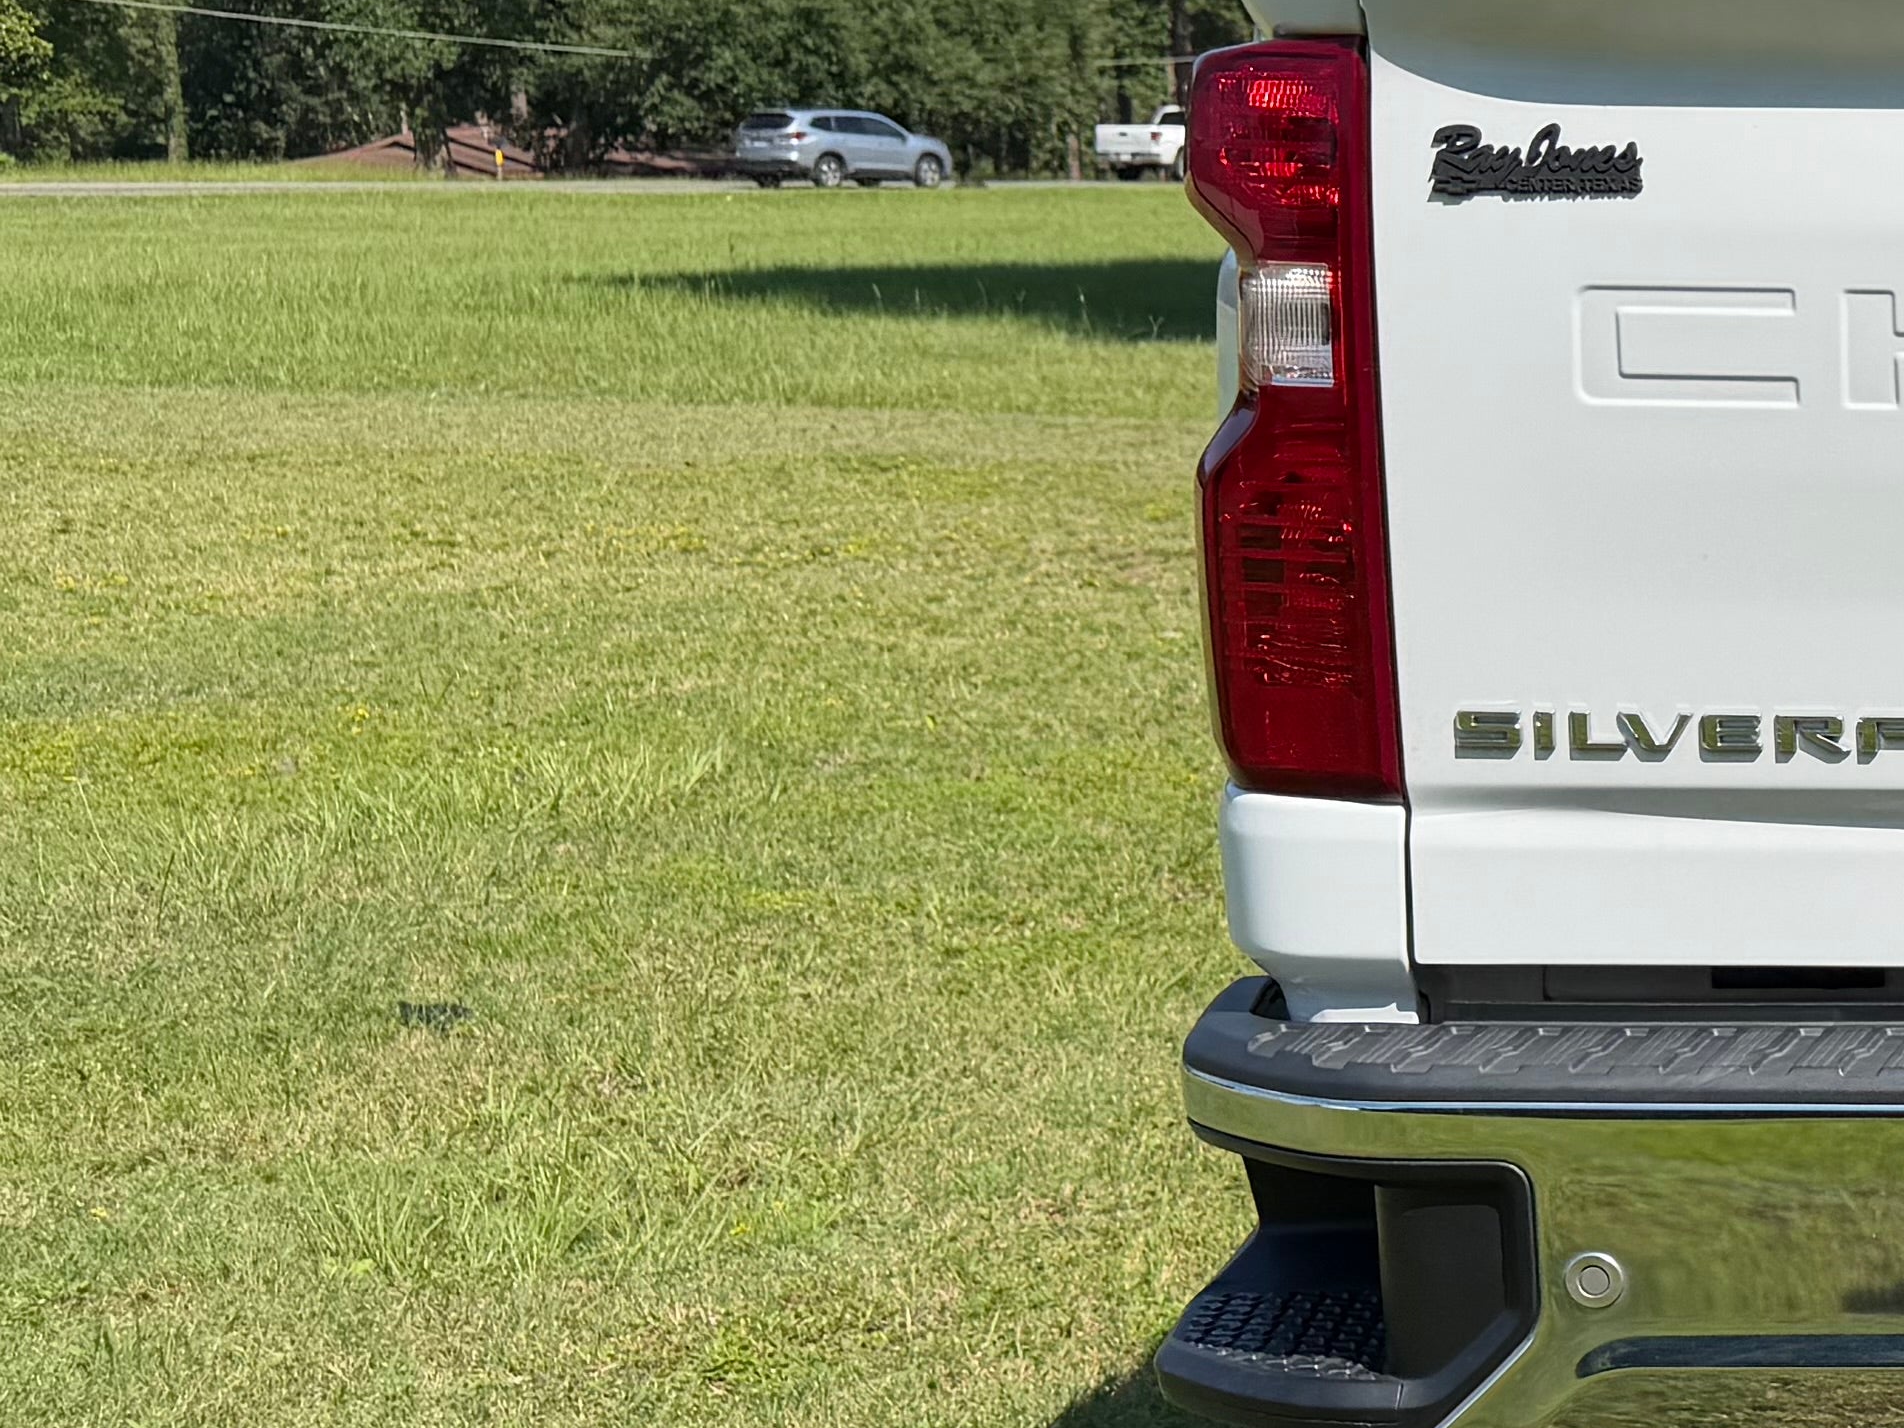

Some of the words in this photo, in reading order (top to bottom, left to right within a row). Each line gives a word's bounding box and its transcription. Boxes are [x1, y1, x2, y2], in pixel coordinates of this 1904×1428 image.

[1431, 123, 1524, 183] Ray
[1524, 122, 1643, 177] Jones
[1579, 177, 1643, 193] TEXAS
